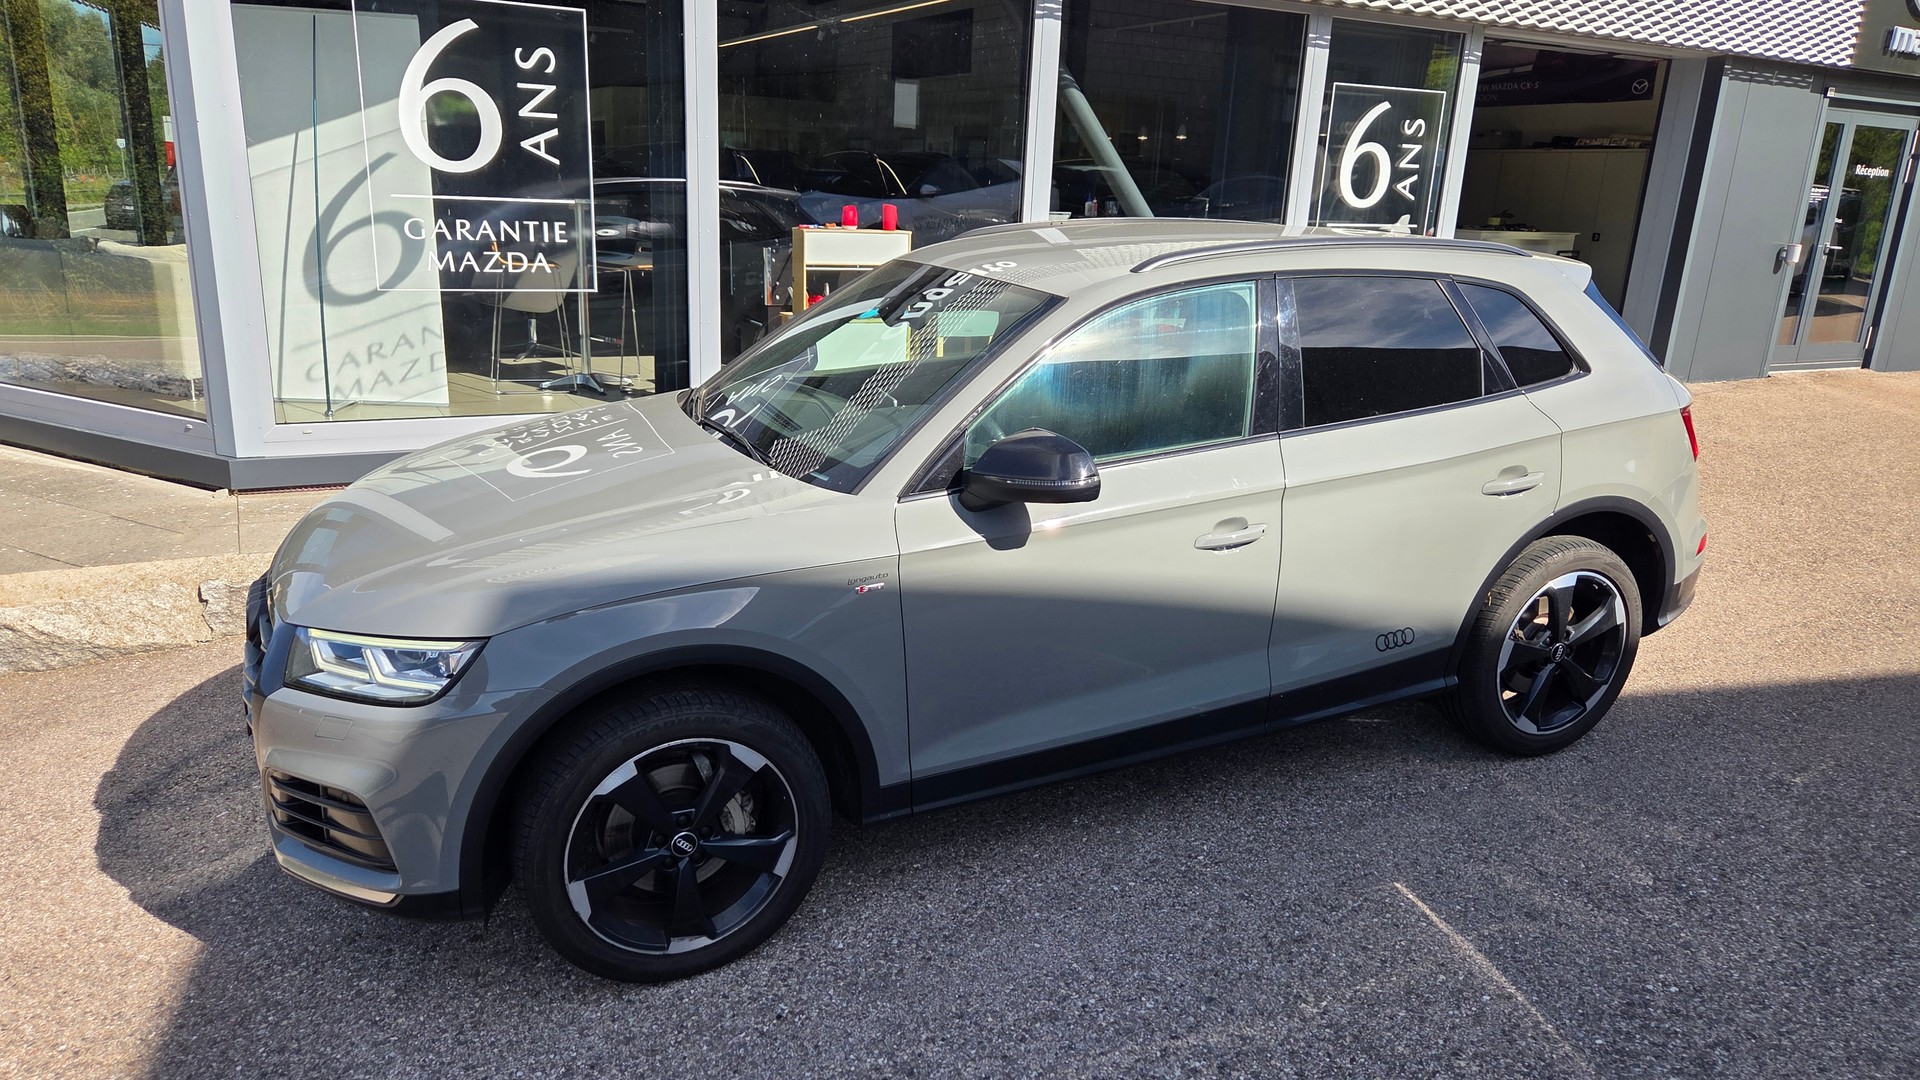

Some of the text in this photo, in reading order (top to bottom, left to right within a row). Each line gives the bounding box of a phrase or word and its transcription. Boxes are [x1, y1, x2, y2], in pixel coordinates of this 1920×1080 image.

[399, 18, 561, 173] 6 ANS
[1339, 101, 1426, 209] 6 ANS
[1855, 164, 1890, 179] Réception
[404, 217, 569, 244] GARANTIE
[428, 251, 552, 274] MAZDA
